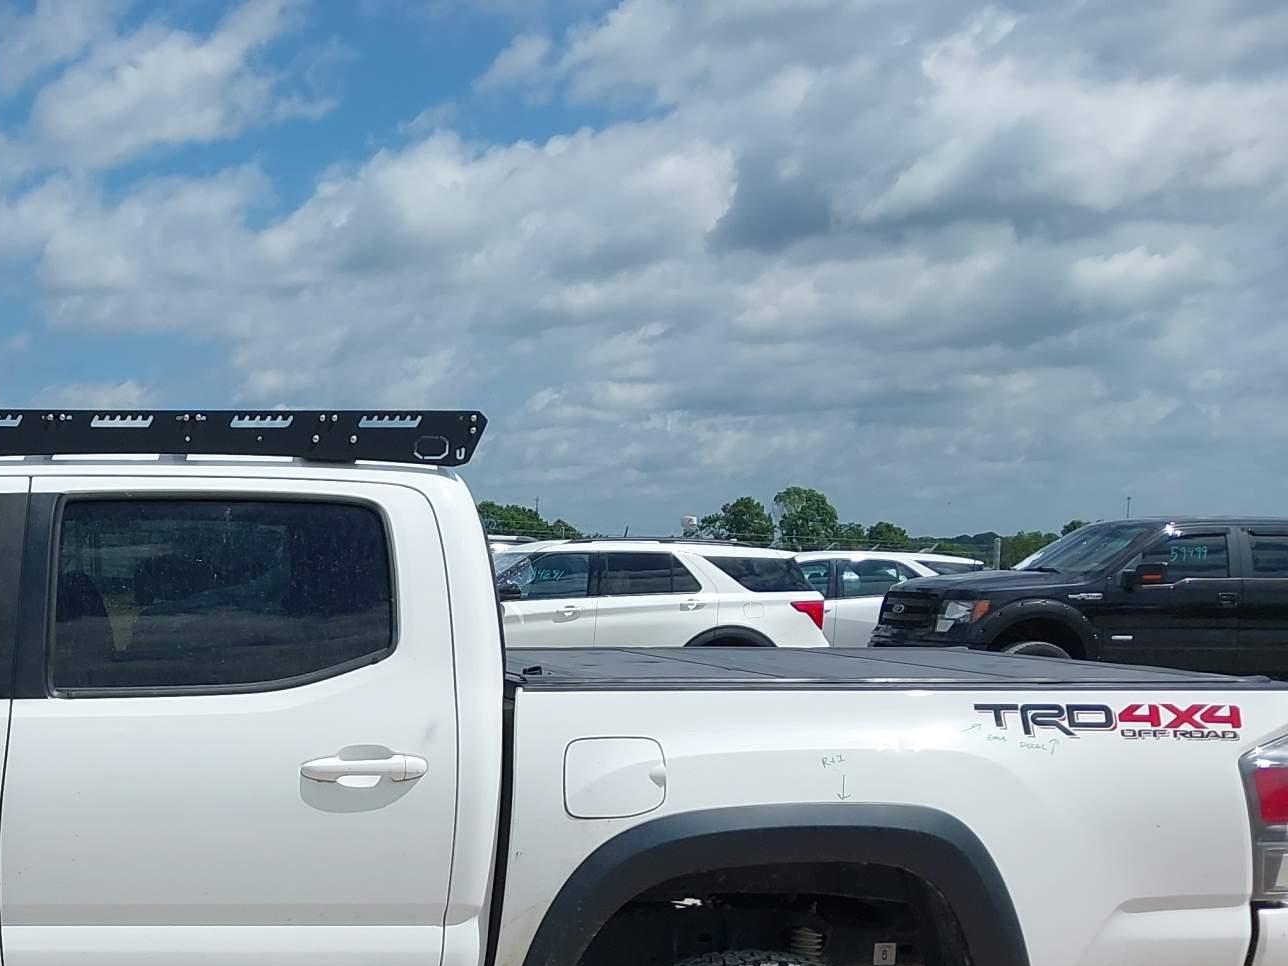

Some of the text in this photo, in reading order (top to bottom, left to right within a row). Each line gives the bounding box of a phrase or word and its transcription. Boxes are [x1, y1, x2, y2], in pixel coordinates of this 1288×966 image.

[973, 703, 1115, 738] TRD
[1120, 728, 1241, 741] OFF ROAD
